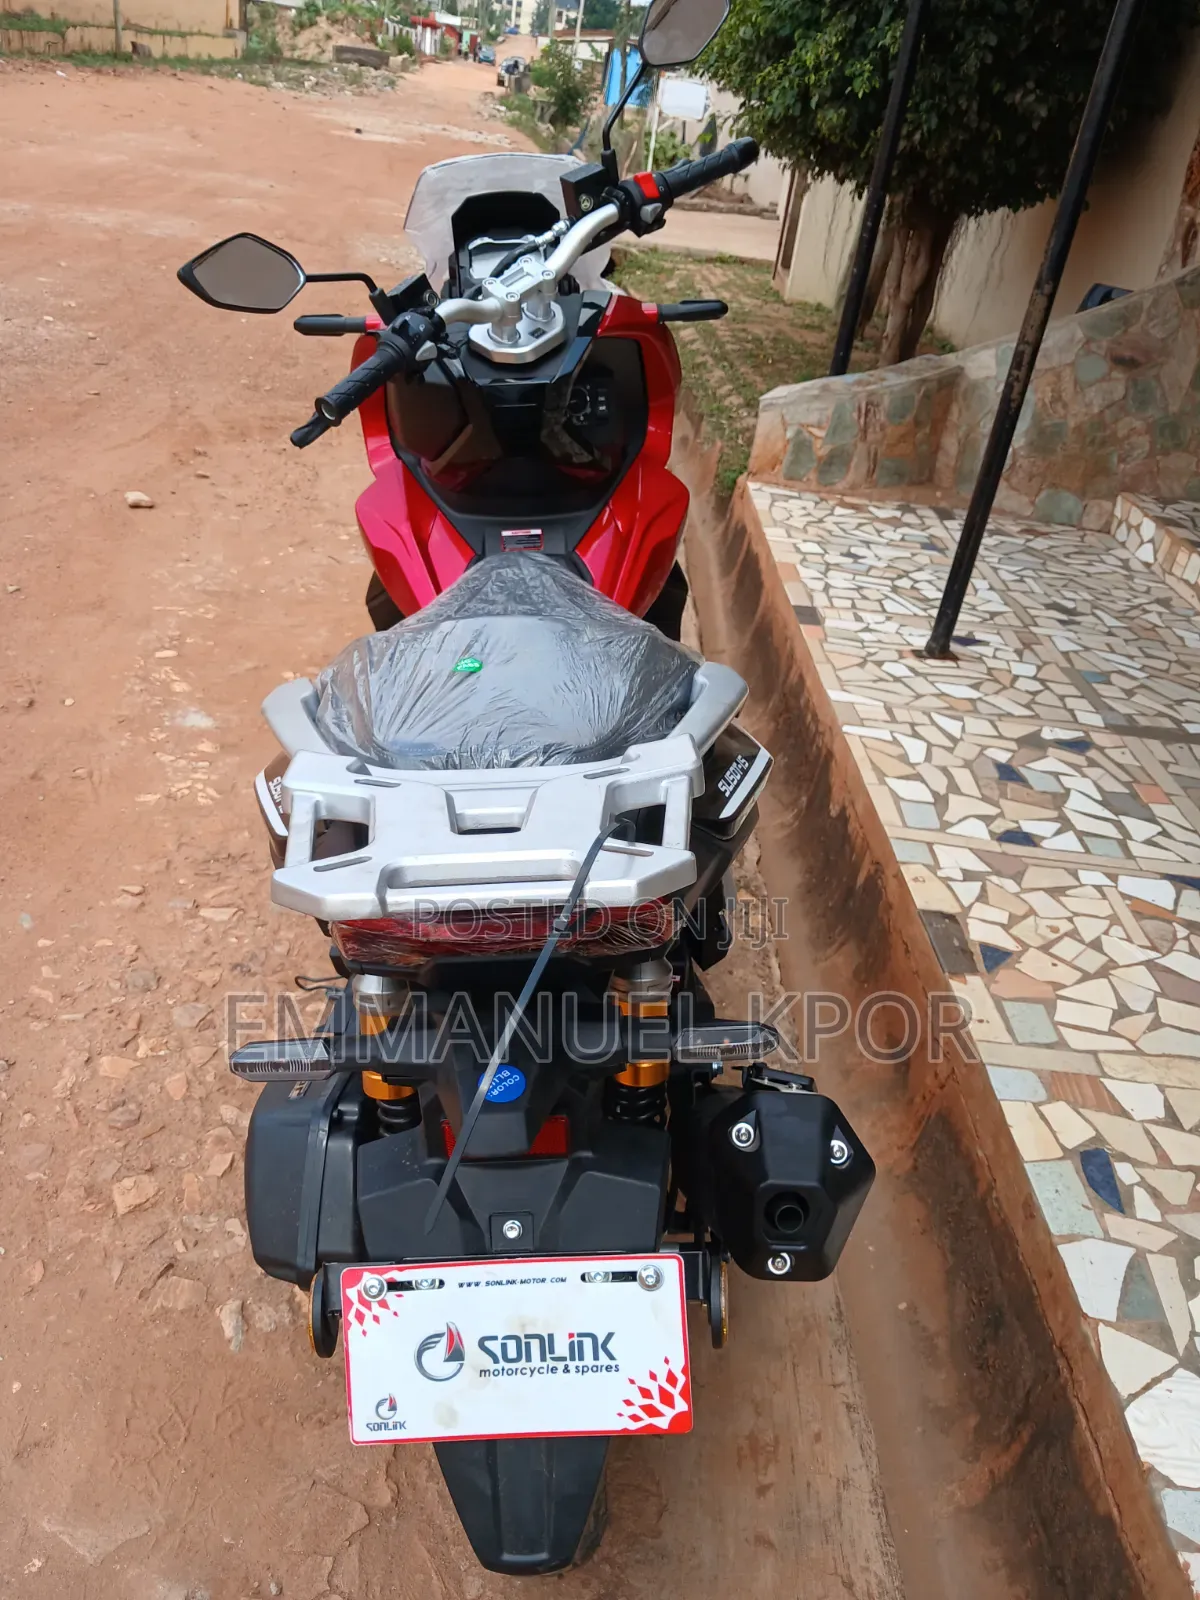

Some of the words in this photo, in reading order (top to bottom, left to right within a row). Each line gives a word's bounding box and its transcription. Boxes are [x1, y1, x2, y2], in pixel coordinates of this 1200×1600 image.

[487, 1074, 520, 1097] COLOR:
[479, 1363, 559, 1378] motorcycle
[562, 1363, 571, 1374] &
[574, 1363, 620, 1376] spares
